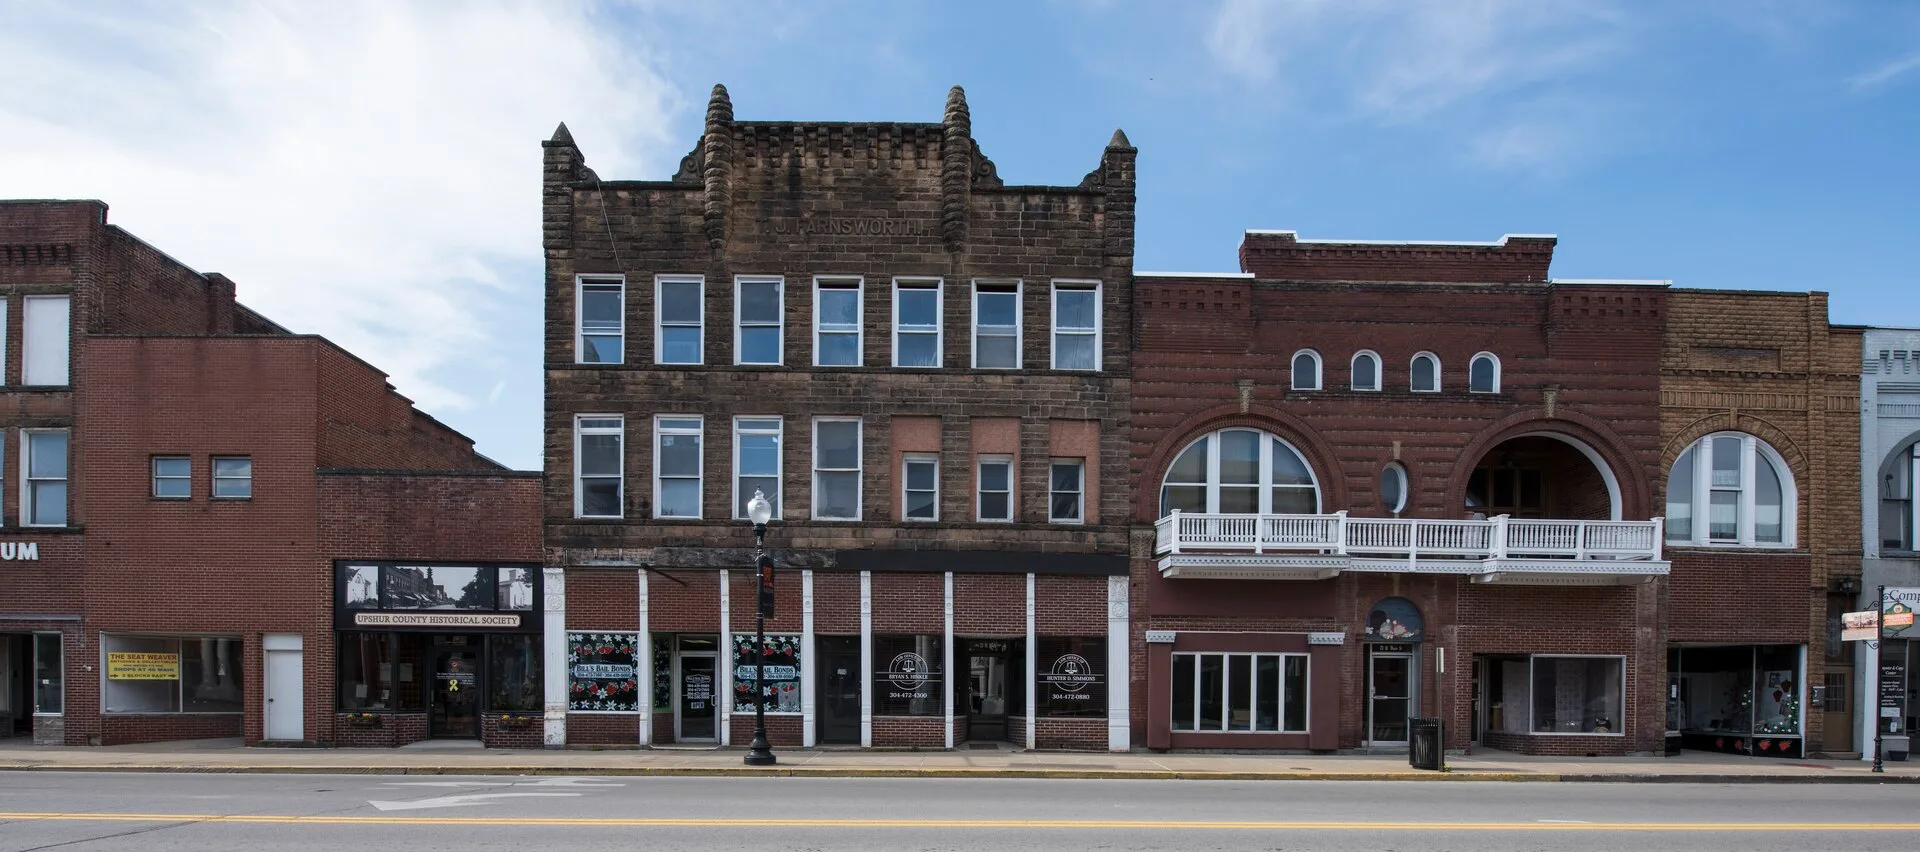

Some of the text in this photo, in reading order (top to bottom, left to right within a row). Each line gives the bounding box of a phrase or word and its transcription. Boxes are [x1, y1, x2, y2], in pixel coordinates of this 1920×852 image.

[357, 615, 518, 625] UPSHUR COUNTY HISTORICAL SOCIETY
